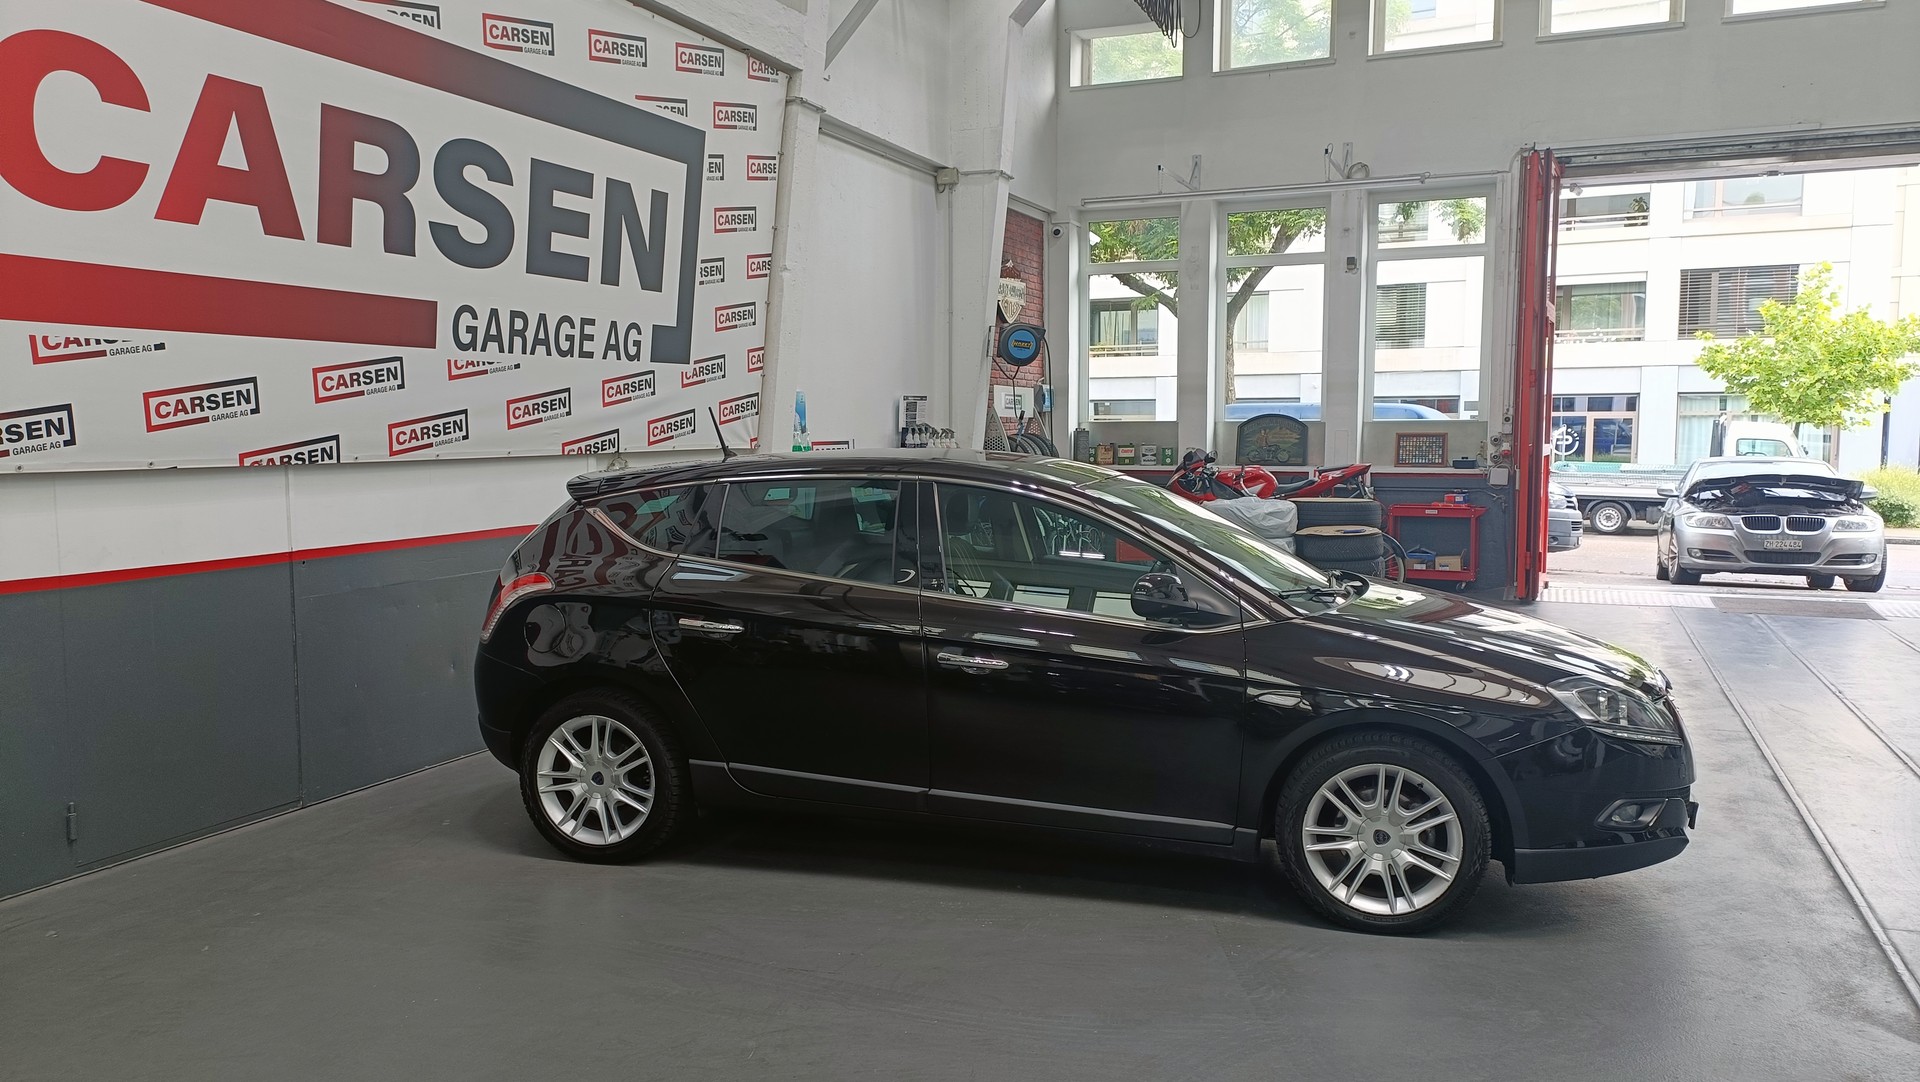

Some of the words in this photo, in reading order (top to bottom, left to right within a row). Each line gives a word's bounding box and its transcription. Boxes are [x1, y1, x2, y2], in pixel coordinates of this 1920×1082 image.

[489, 24, 550, 46] CARSEN
[593, 38, 644, 58] CARSEN
[680, 51, 721, 68] CARSEN
[717, 110, 754, 123] CARSEN
[0, 28, 669, 292] CARSEN
[718, 214, 754, 226] CARSEN
[718, 309, 753, 324] CARSEN
[452, 304, 597, 360] GARAGE
[602, 320, 642, 362] AG
[109, 346, 140, 357] GARAGE
[141, 345, 152, 353] AG
[321, 366, 398, 392] CARSEN
[606, 377, 652, 399] CARSEN
[366, 386, 388, 395] GARAGE
[154, 388, 252, 419] CARSEN
[512, 396, 567, 420] CARSEN
[722, 400, 757, 418] CARSEN
[211, 411, 238, 422] GARAGE
[239, 409, 249, 417] AG
[0, 417, 65, 445] SEN
[395, 419, 464, 446] CARSEN
[652, 416, 693, 438] CARSEN
[12, 442, 48, 456] GARAGE
[49, 441, 61, 449] AG
[434, 438, 454, 447] GARAGE
[454, 436, 461, 444] AG
